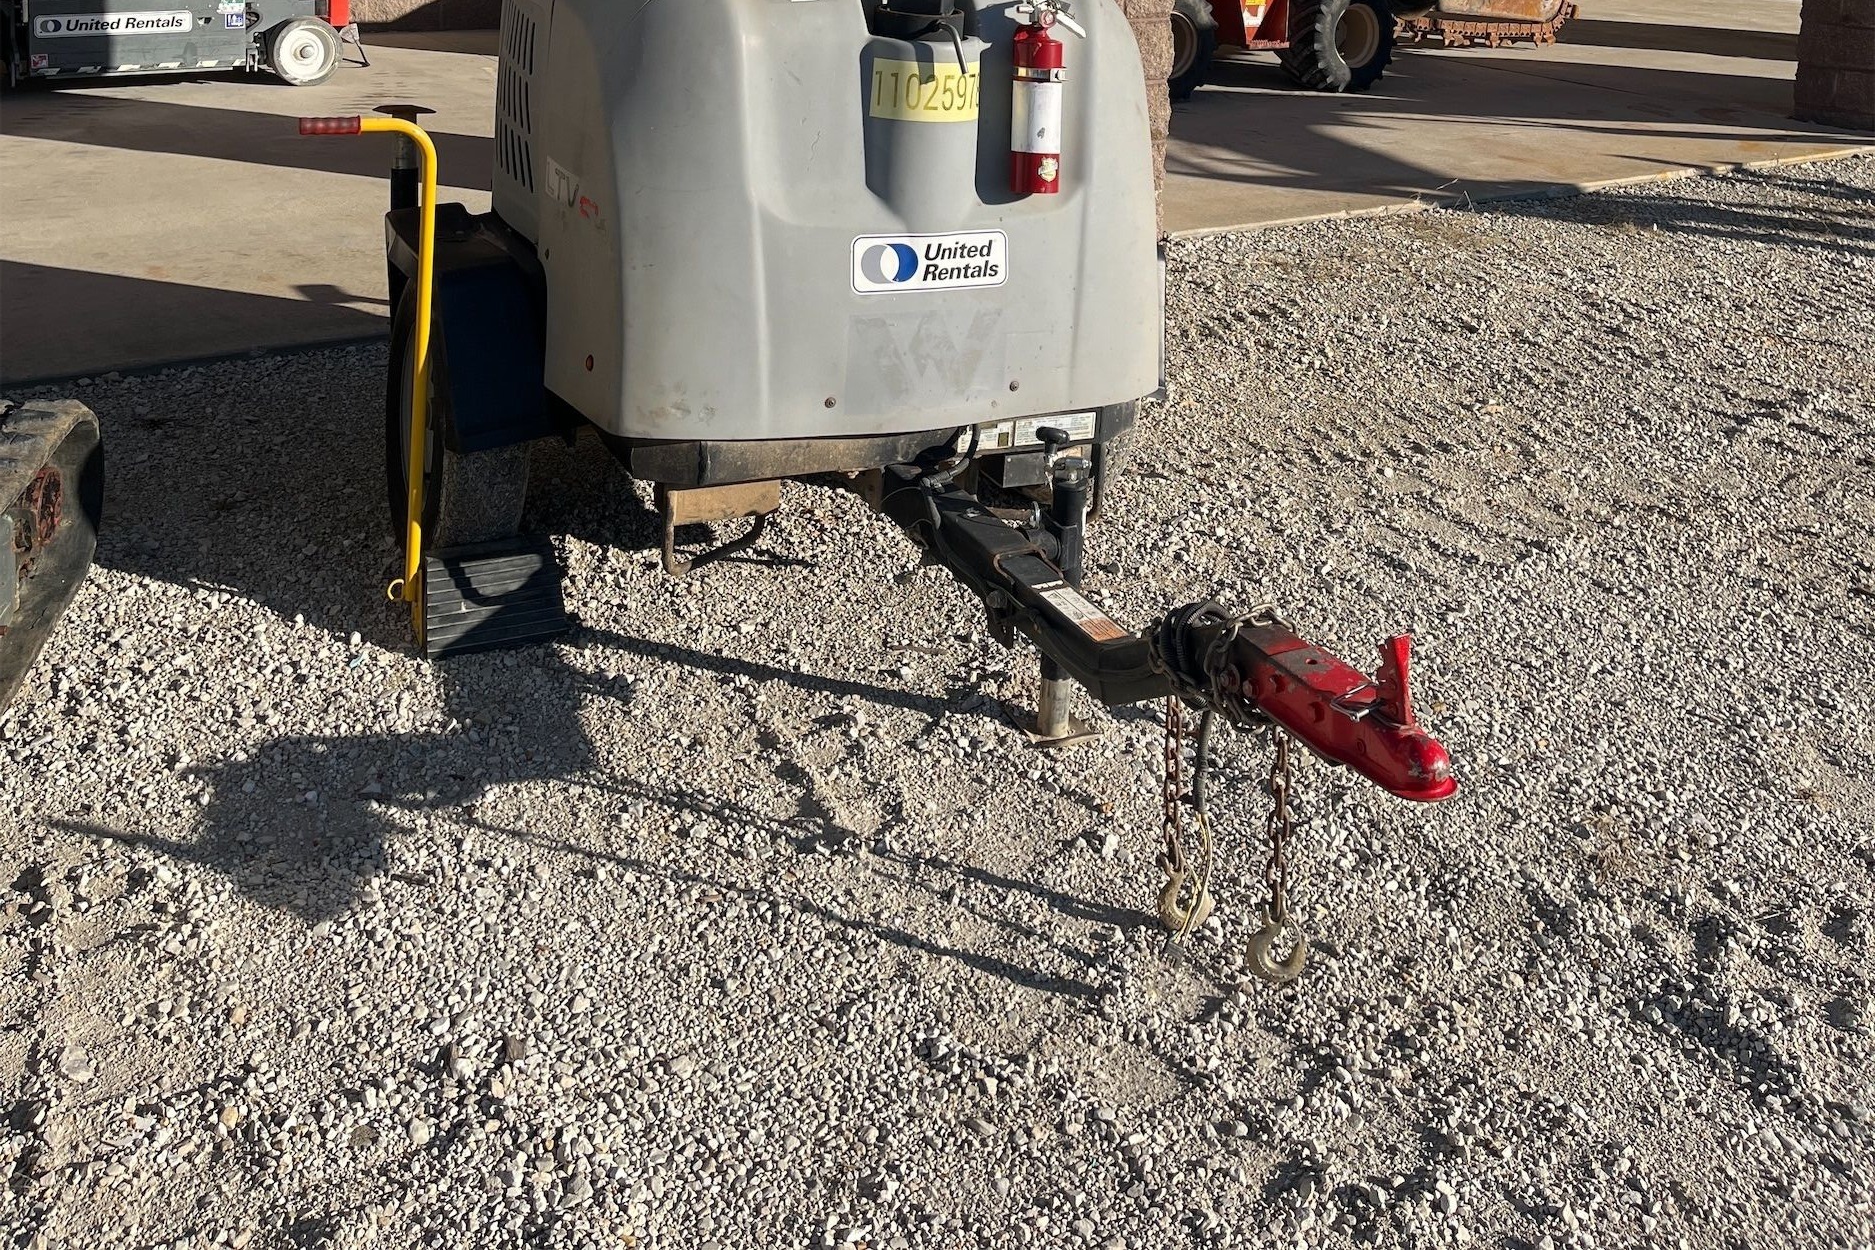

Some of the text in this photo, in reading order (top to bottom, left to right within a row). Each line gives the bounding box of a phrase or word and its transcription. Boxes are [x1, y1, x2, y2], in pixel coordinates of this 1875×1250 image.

[66, 15, 183, 32] United Rentals
[924, 239, 993, 262] United
[922, 259, 999, 282] Rentals
